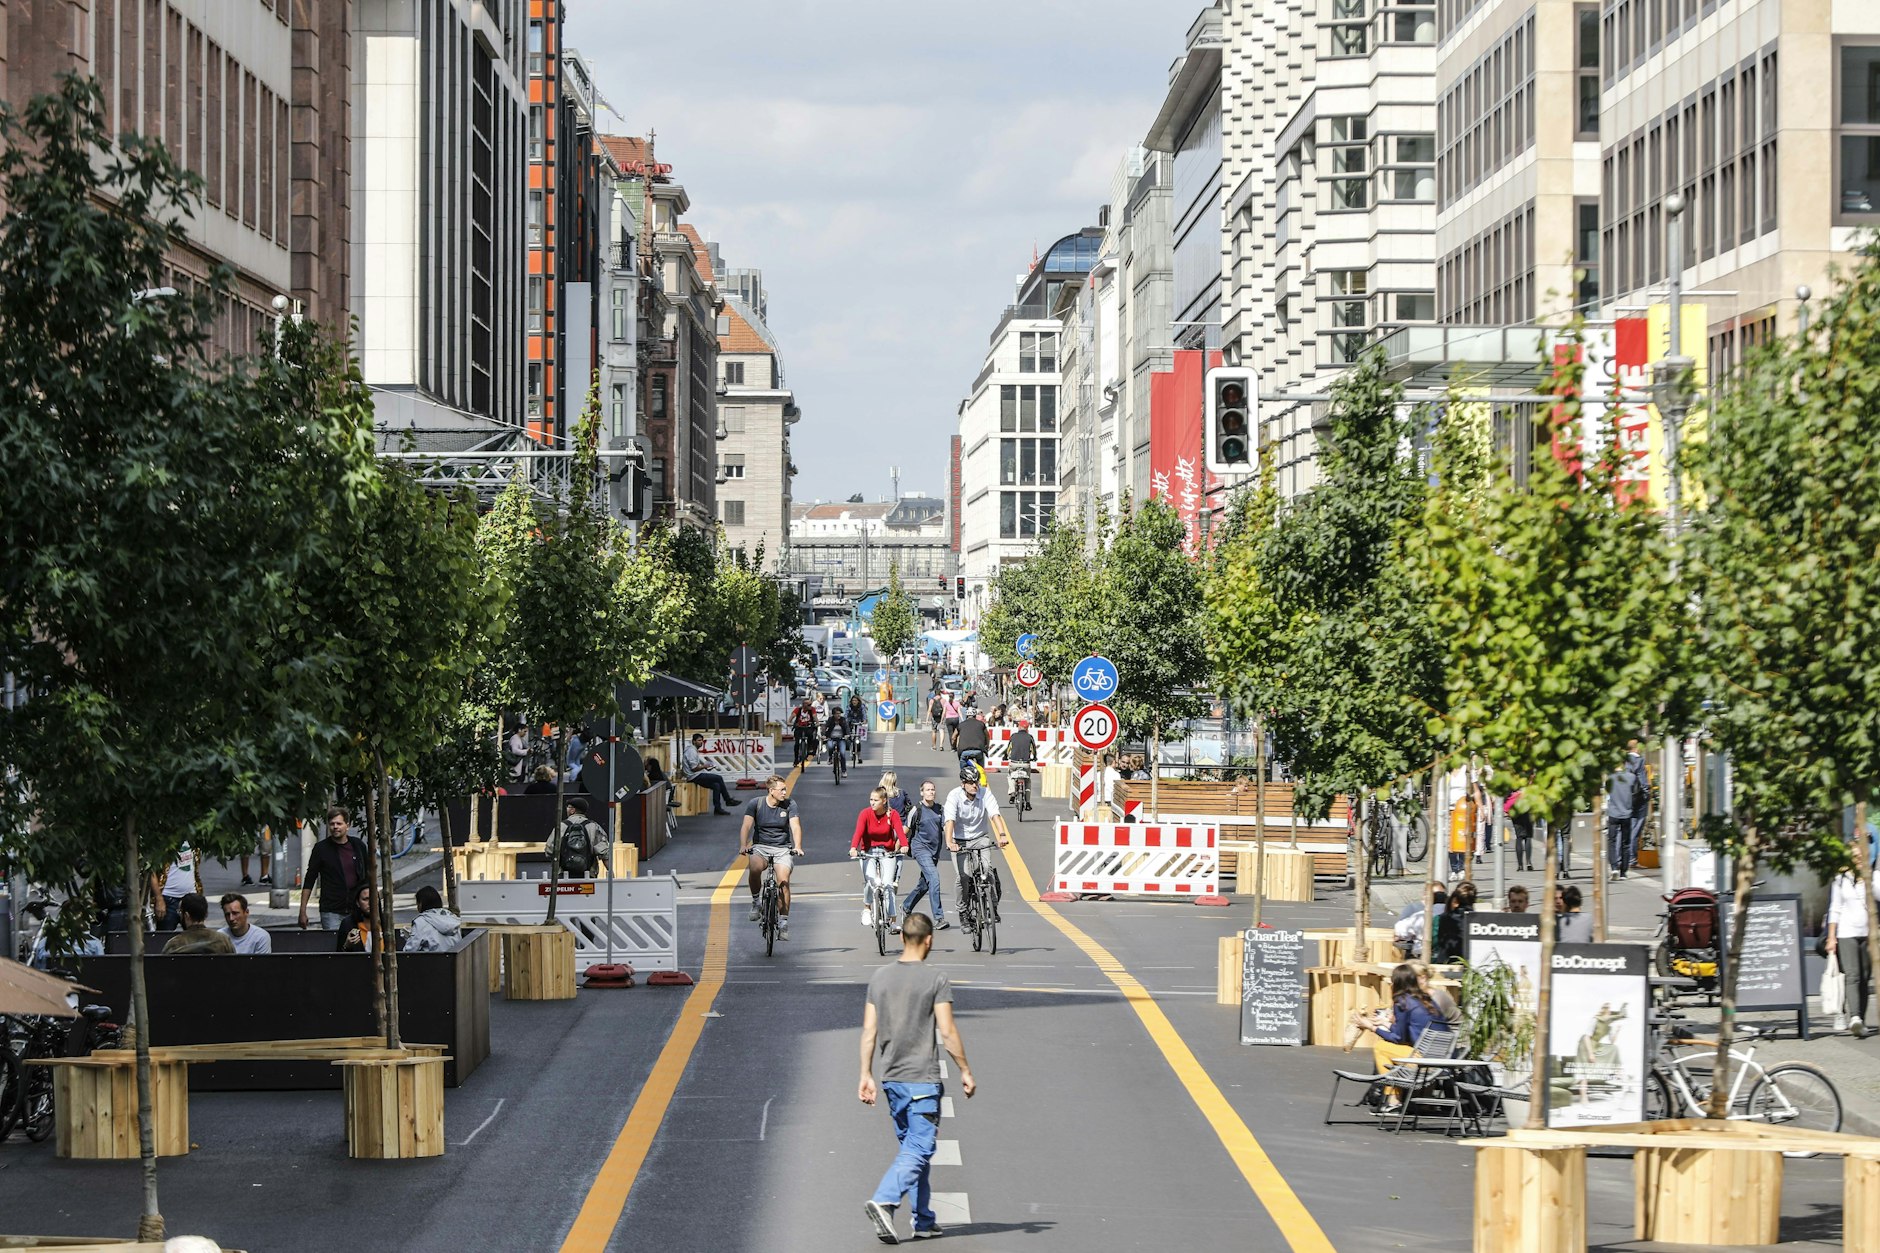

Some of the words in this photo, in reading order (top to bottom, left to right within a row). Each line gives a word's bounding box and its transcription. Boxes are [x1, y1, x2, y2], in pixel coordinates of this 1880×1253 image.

[1617, 363, 1652, 482] REWE
[813, 598, 847, 606] BAHNHOF
[1022, 668, 1036, 679] 20
[1084, 718, 1107, 736] 20
[1245, 929, 1299, 943] ChariTea
[1469, 923, 1538, 939] BoConcept
[1552, 955, 1626, 972] BoConcept
